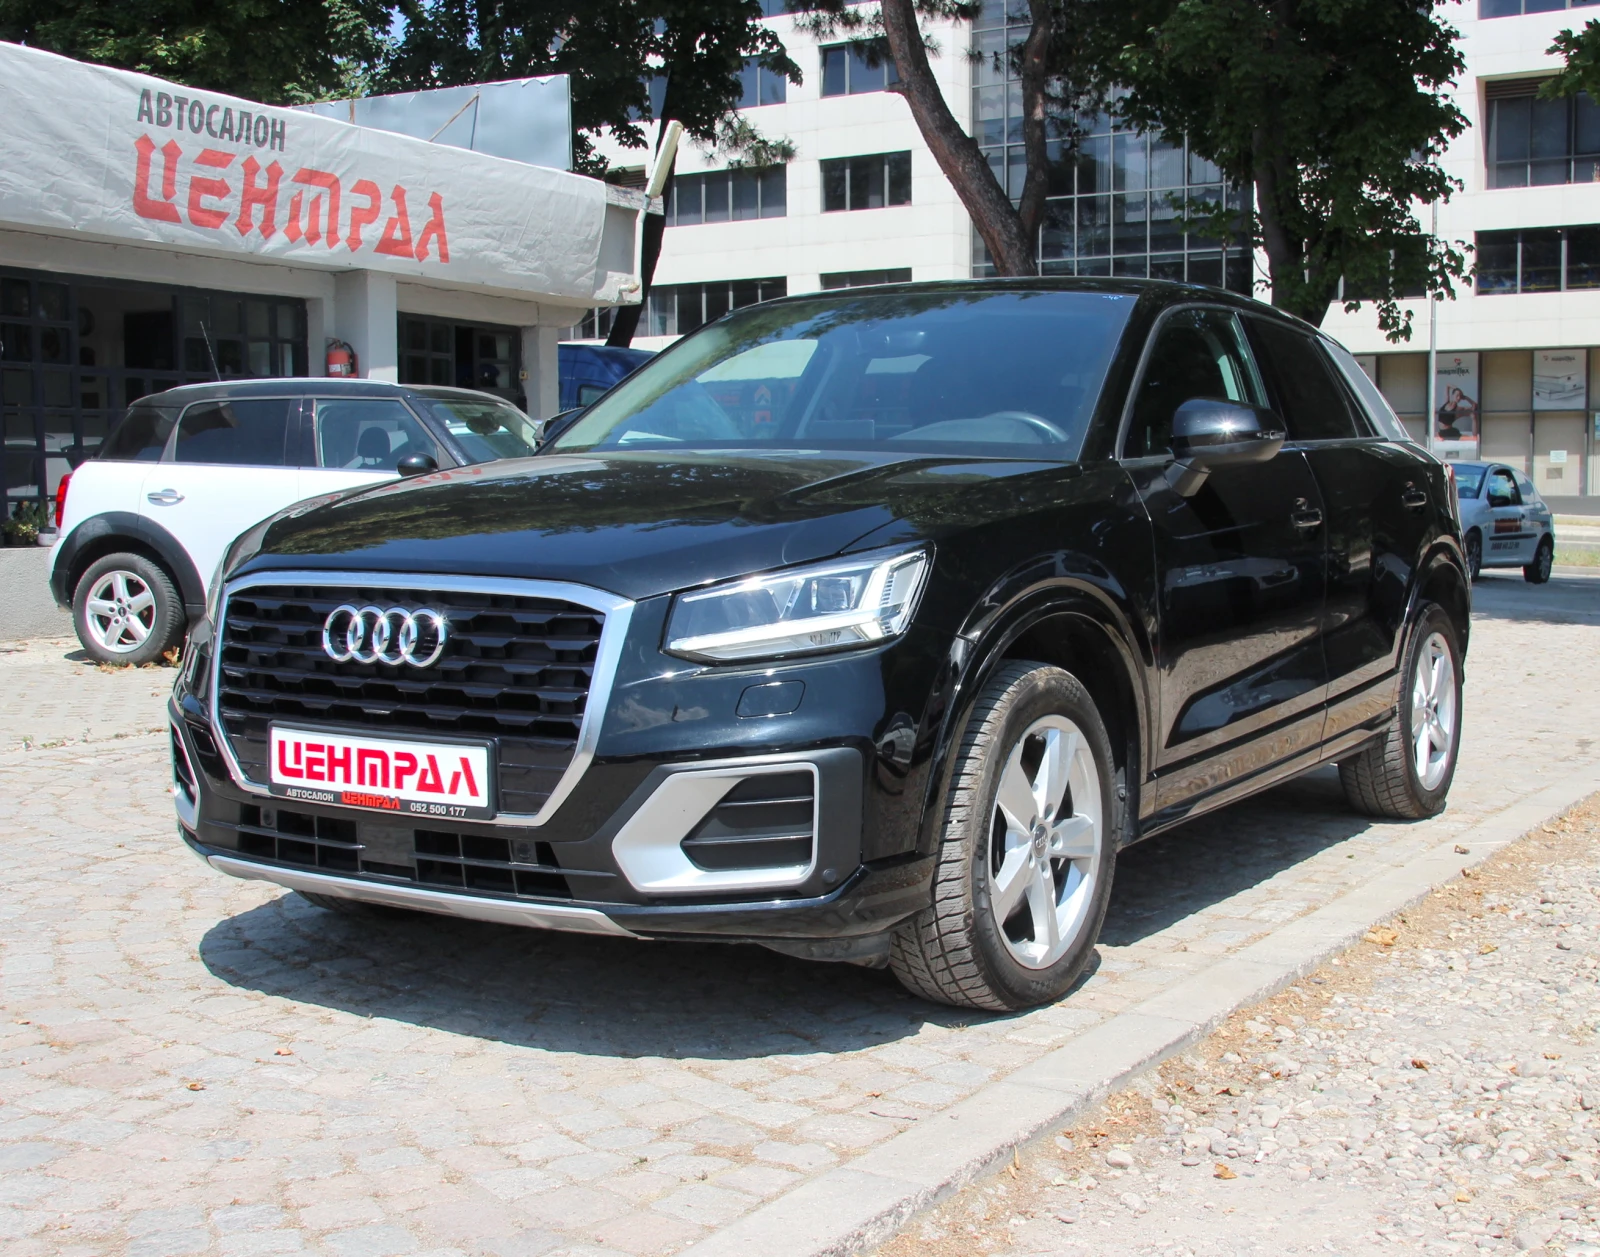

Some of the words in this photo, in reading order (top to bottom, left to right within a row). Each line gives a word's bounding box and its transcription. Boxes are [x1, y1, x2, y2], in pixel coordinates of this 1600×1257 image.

[137, 88, 286, 152] АВТОСАЛОН
[132, 133, 450, 264] ЦЕНТРАЛ
[278, 739, 480, 797] ЦЕНТРАЛ
[286, 788, 334, 802] АВТОСАЛОН
[341, 790, 400, 810] ЦЕНТРАЛ
[410, 802, 428, 813] 052
[429, 804, 447, 815] 500
[449, 805, 467, 817] 177
